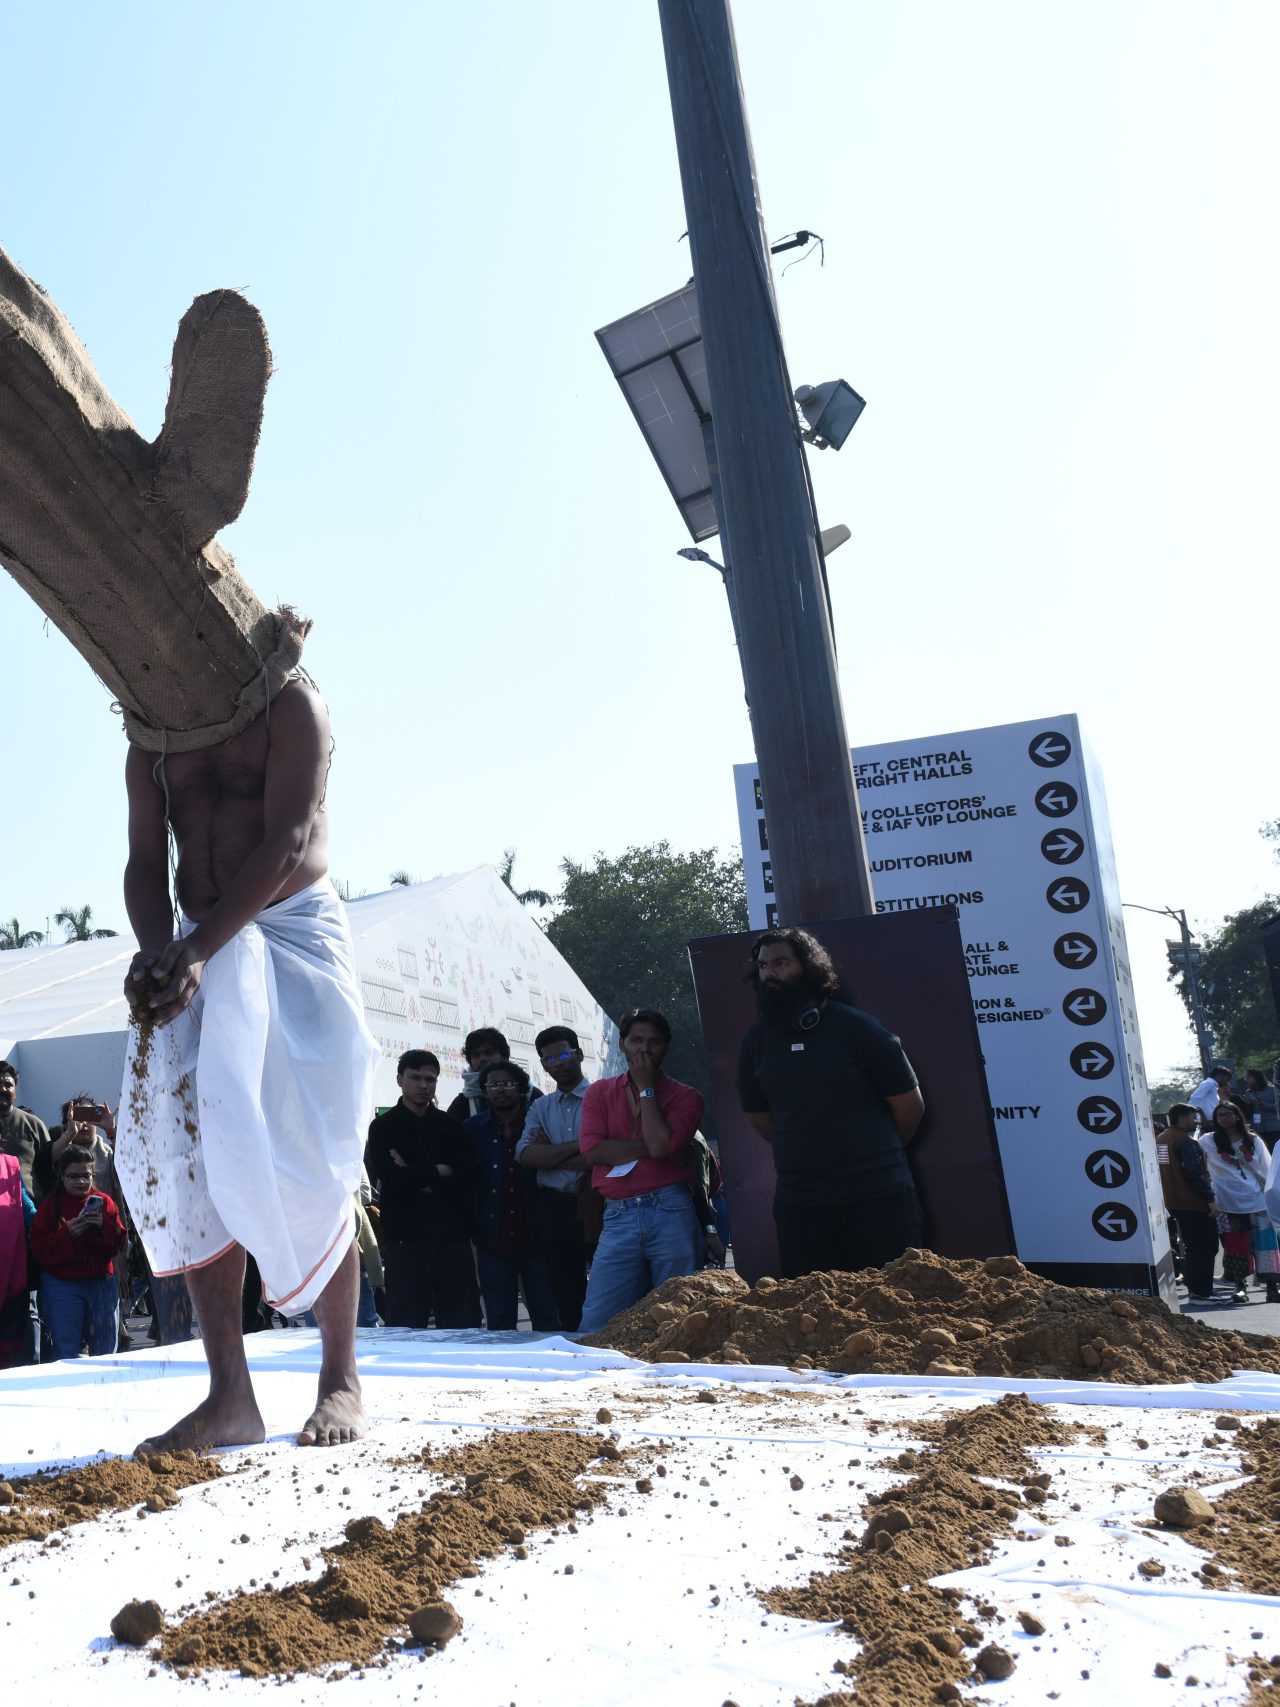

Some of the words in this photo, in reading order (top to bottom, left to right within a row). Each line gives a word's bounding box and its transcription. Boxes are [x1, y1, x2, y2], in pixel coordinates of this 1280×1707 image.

[887, 750, 972, 772] CENTRAL
[855, 771, 910, 790] RIGHT
[913, 762, 973, 782] HALLS
[872, 821, 884, 833] &
[886, 817, 914, 831] IAF
[915, 814, 944, 828] VIP
[946, 804, 1017, 824] LOUNGE
[875, 891, 984, 913] STITUTIONS
[965, 942, 995, 954] ALL
[998, 940, 1010, 951] &
[966, 963, 1019, 977] OUNGE
[973, 998, 1001, 1010] ION
[1004, 997, 1016, 1008] &
